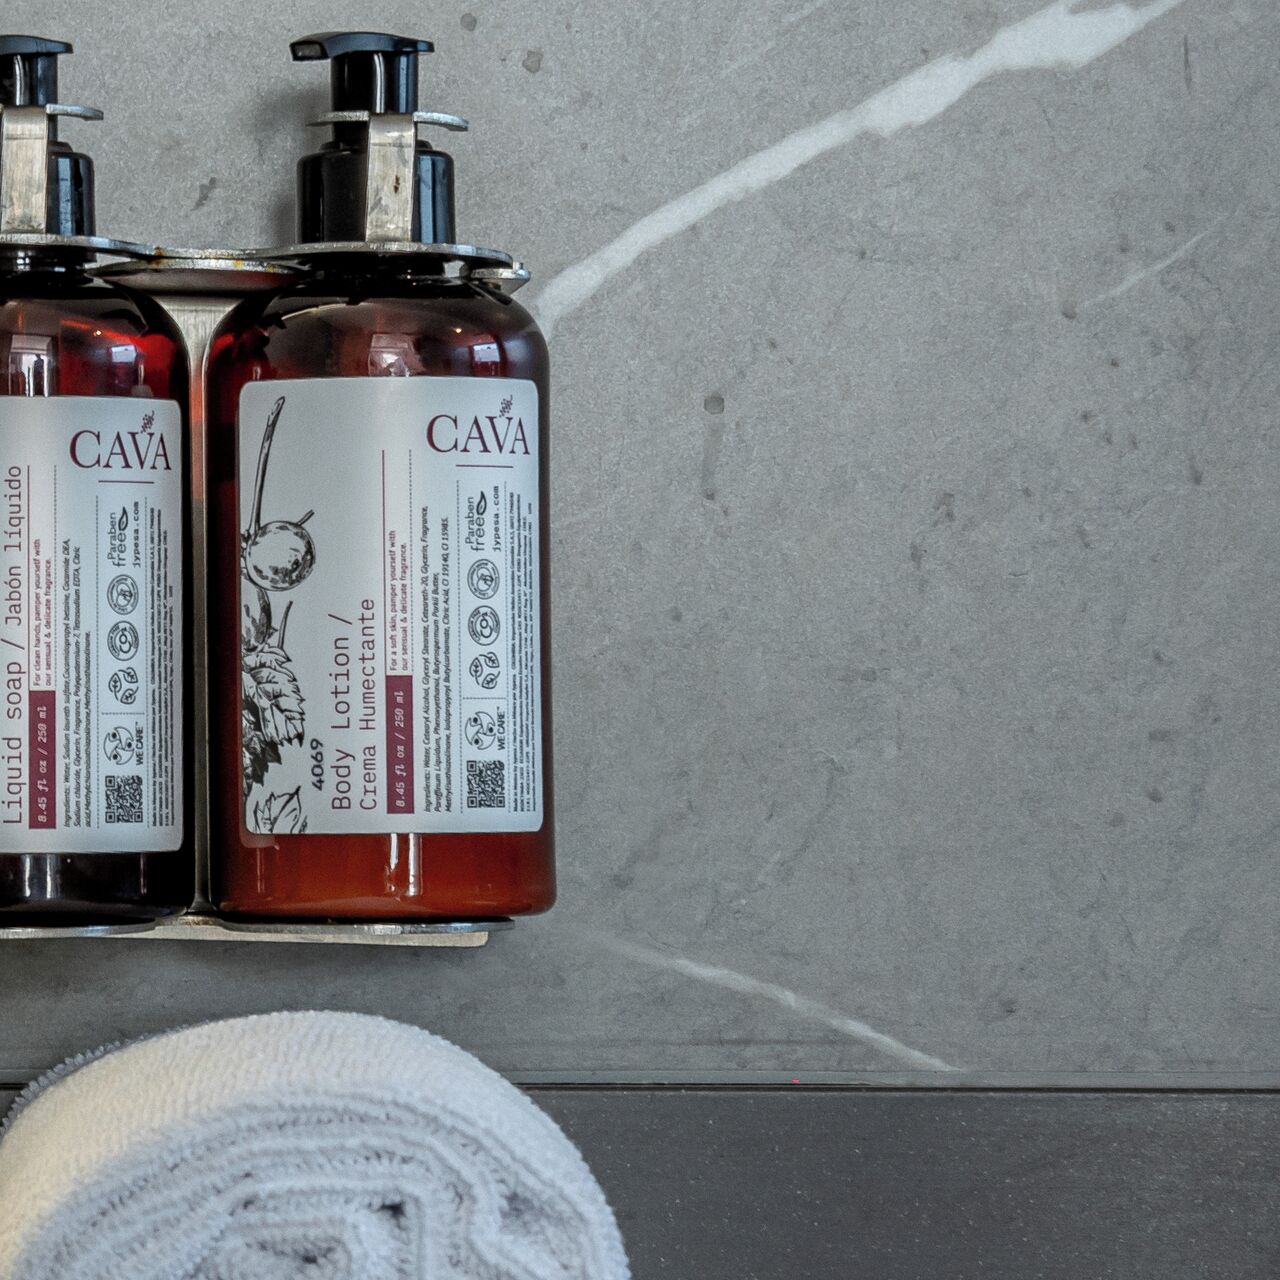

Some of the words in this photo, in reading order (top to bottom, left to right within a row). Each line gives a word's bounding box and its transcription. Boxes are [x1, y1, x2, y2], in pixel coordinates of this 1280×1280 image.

[426, 414, 531, 455] CAVA
[69, 429, 172, 471] CAVA
[4, 465, 27, 553] líquido
[464, 496, 475, 545] Paraben
[492, 485, 501, 553] jypesa.com
[33, 538, 42, 558] with
[107, 512, 117, 560] Paraben
[132, 501, 141, 569] jypesa.com
[470, 516, 485, 553] free
[112, 532, 127, 568] free
[399, 542, 409, 581] fragrance.
[33, 558, 42, 591] yourself
[44, 559, 53, 597] fragrance.
[389, 550, 399, 582] yourself
[4, 565, 23, 626] Jabón
[33, 592, 42, 622] pamper
[390, 583, 399, 613] pamper
[400, 583, 408, 615] delicate
[44, 598, 52, 630] delicate
[328, 613, 353, 626] /
[390, 613, 398, 633] skin,
[400, 616, 408, 624] &
[0, 639, 25, 651] /
[33, 622, 42, 649] hands,
[44, 632, 52, 640] &
[390, 634, 398, 650] soft
[400, 625, 408, 656] sensual
[33, 650, 42, 672] clean
[44, 641, 52, 671] sensual
[358, 599, 376, 731] Humectante
[390, 657, 398, 671] For
[400, 656, 408, 671] our
[5, 661, 27, 721] soap
[33, 672, 42, 687] For
[44, 672, 52, 687] our
[329, 637, 351, 730] Lotion
[395, 690, 406, 704] ml
[37, 705, 48, 720] ml
[395, 708, 406, 728] 250
[37, 724, 48, 744] 250
[395, 732, 406, 741] /
[497, 735, 505, 751] WE
[37, 747, 48, 756] /
[135, 751, 143, 766] WE
[310, 738, 325, 792] 4069
[395, 745, 406, 759] oz
[1, 737, 27, 824] Liquid
[37, 760, 48, 774] oz
[330, 750, 356, 811] Body
[360, 744, 377, 811] Crema
[395, 763, 406, 777] fl
[37, 779, 48, 792] fl
[395, 781, 406, 808] 8.45
[37, 797, 48, 823] 8.45
